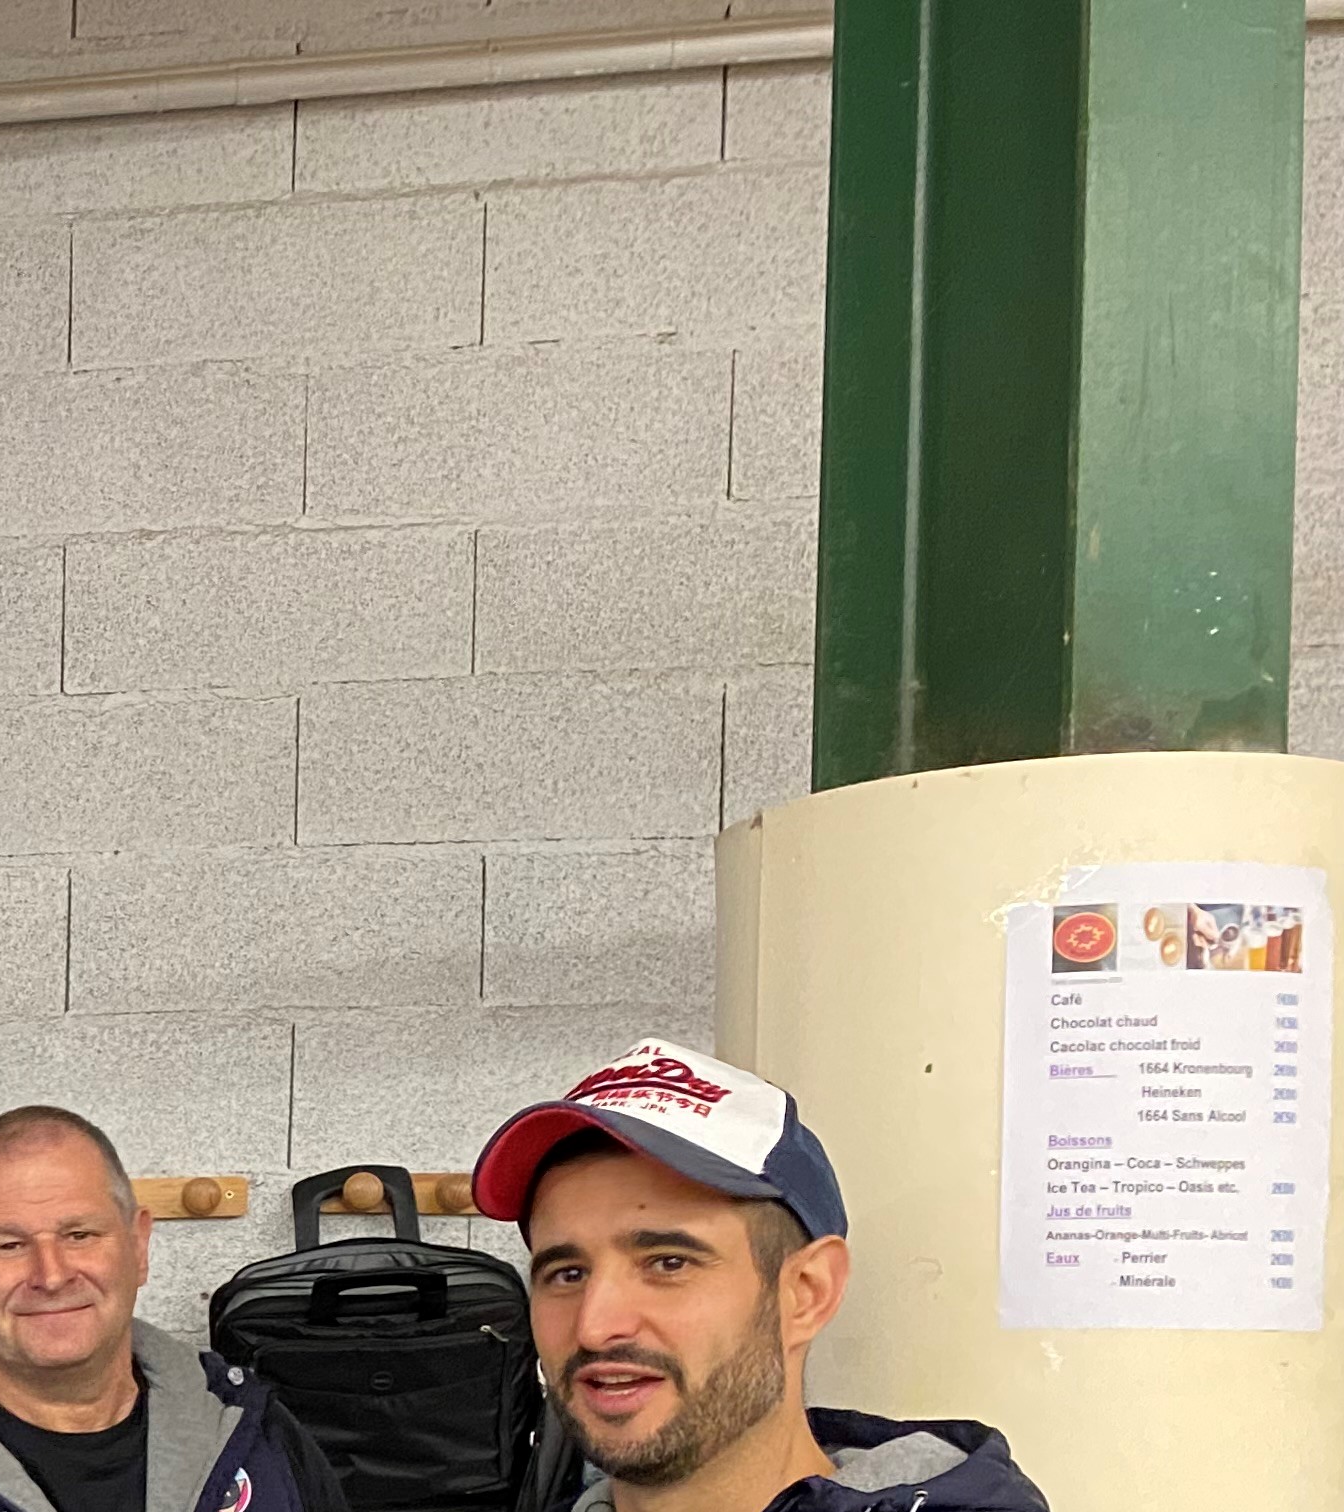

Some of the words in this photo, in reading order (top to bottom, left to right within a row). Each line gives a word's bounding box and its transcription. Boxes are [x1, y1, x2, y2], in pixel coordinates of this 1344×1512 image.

[1050, 993, 1083, 1006] Café
[1050, 1017, 1113, 1030] Chocolat
[1116, 1015, 1158, 1028] chaud
[1050, 1041, 1107, 1053] Cacolac
[1109, 1039, 1168, 1052] chocolat
[1170, 1038, 1201, 1051] froid
[1049, 1064, 1094, 1077] Bières
[1139, 1062, 1170, 1074] 1664
[1173, 1061, 1253, 1079] Kronenbourg
[1141, 1086, 1202, 1098] Heineken
[1137, 1109, 1168, 1122] 1664
[1172, 1109, 1204, 1122] Sans
[1207, 1109, 1247, 1122] Alcool
[1048, 1134, 1113, 1148] Boissons
[1047, 1157, 1111, 1173] Orangina
[1127, 1157, 1161, 1170] Coca
[1175, 1156, 1246, 1173] Schweppes
[1047, 1181, 1068, 1193] Ice
[1071, 1181, 1096, 1193] Tea
[1112, 1181, 1163, 1196] Tropico
[1178, 1180, 1214, 1193] Oasis
[1046, 1204, 1071, 1217] Jus
[1075, 1204, 1093, 1217] de
[1096, 1203, 1132, 1217] fruits
[1046, 1251, 1080, 1264] Eaux
[1121, 1251, 1168, 1264] Perrier
[1119, 1274, 1176, 1287] Minérale
